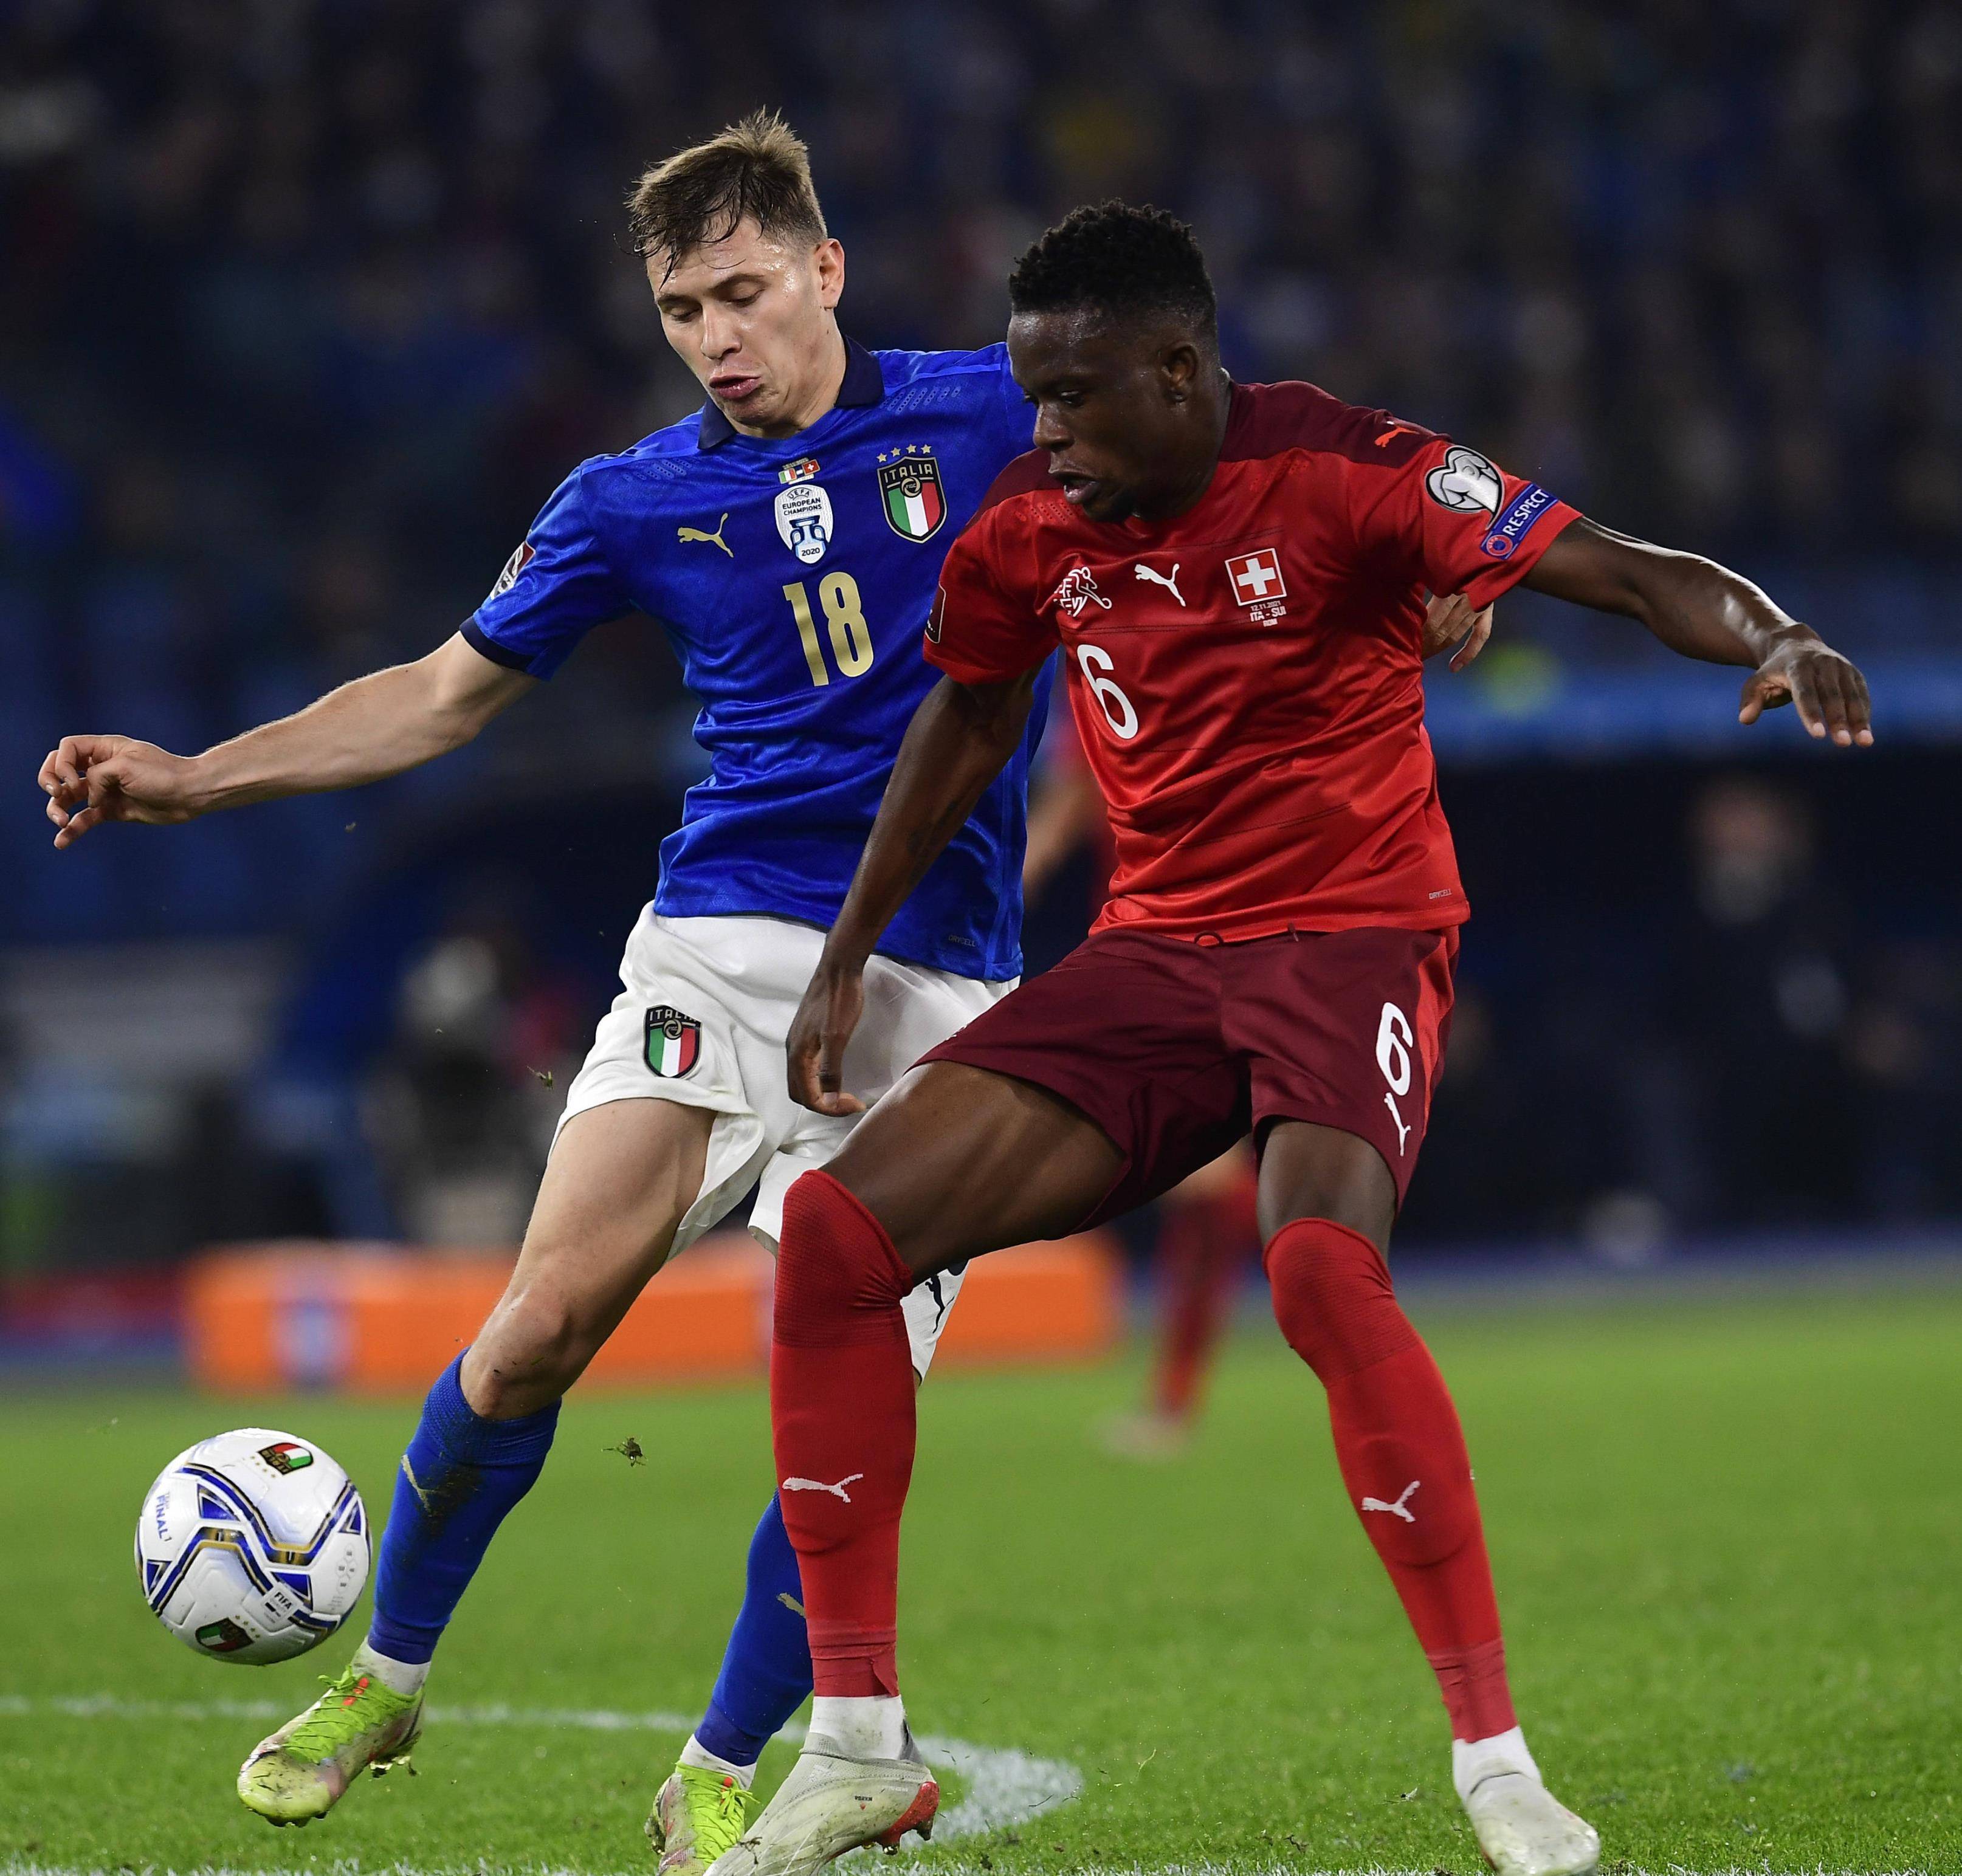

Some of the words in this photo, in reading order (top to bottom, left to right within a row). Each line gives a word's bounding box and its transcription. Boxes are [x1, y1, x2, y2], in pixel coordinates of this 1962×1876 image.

[884, 463, 933, 483] ITALIA
[788, 489, 810, 499] UEFA
[782, 497, 821, 510] EUROPEAN
[783, 504, 822, 516] CHAMPIONS
[1502, 489, 1549, 536] RESPECT
[801, 547, 821, 556] 2020
[1250, 611, 1265, 622] ITA
[1271, 606, 1287, 617] SUI
[782, 572, 874, 687] 18
[1076, 644, 1138, 739] 6
[1375, 1002, 1414, 1096] 6
[156, 1494, 168, 1539] FINAL
[274, 1592, 292, 1609] FIFA
